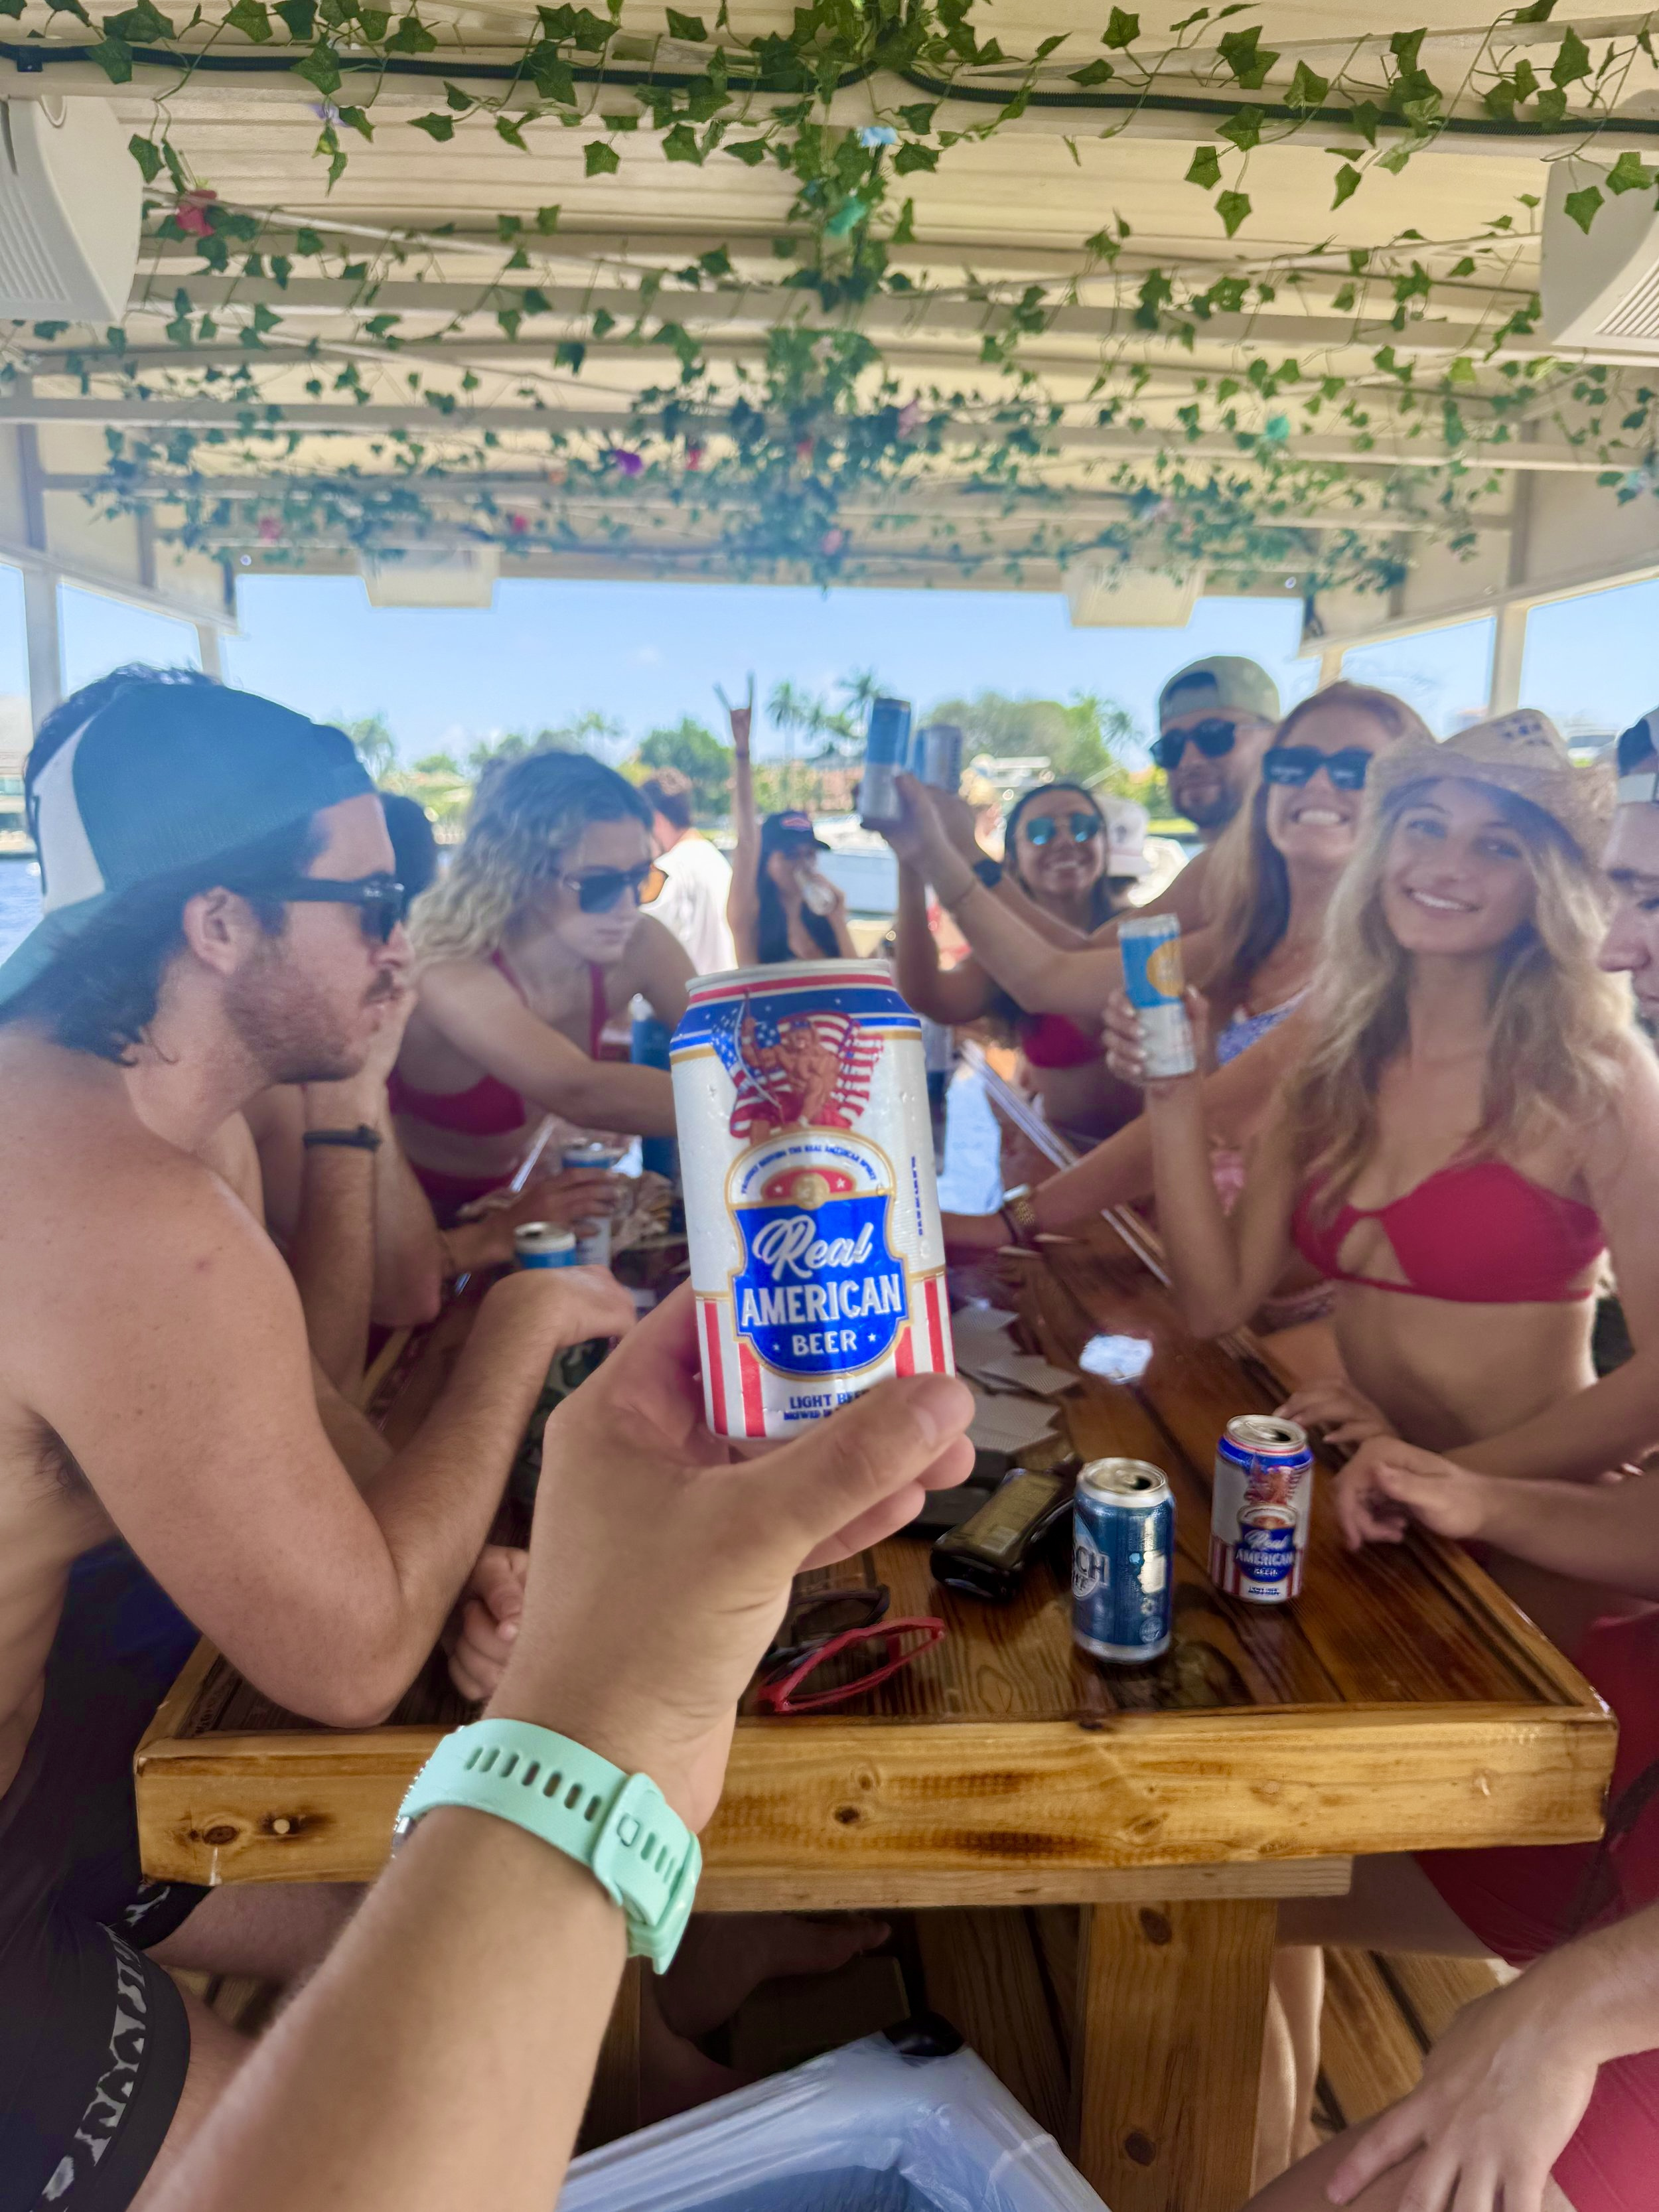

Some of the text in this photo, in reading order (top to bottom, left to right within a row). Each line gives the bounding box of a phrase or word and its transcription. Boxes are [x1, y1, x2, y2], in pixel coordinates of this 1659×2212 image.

[752, 1214, 874, 1281] Real
[741, 1273, 902, 1327] AMERICAN
[792, 1329, 858, 1356] BEER
[790, 1394, 832, 1409] LIGHT
[1244, 1529, 1291, 1551] Real
[1074, 1546, 1110, 1587] CH
[1236, 1548, 1295, 1566] AMERICAN
